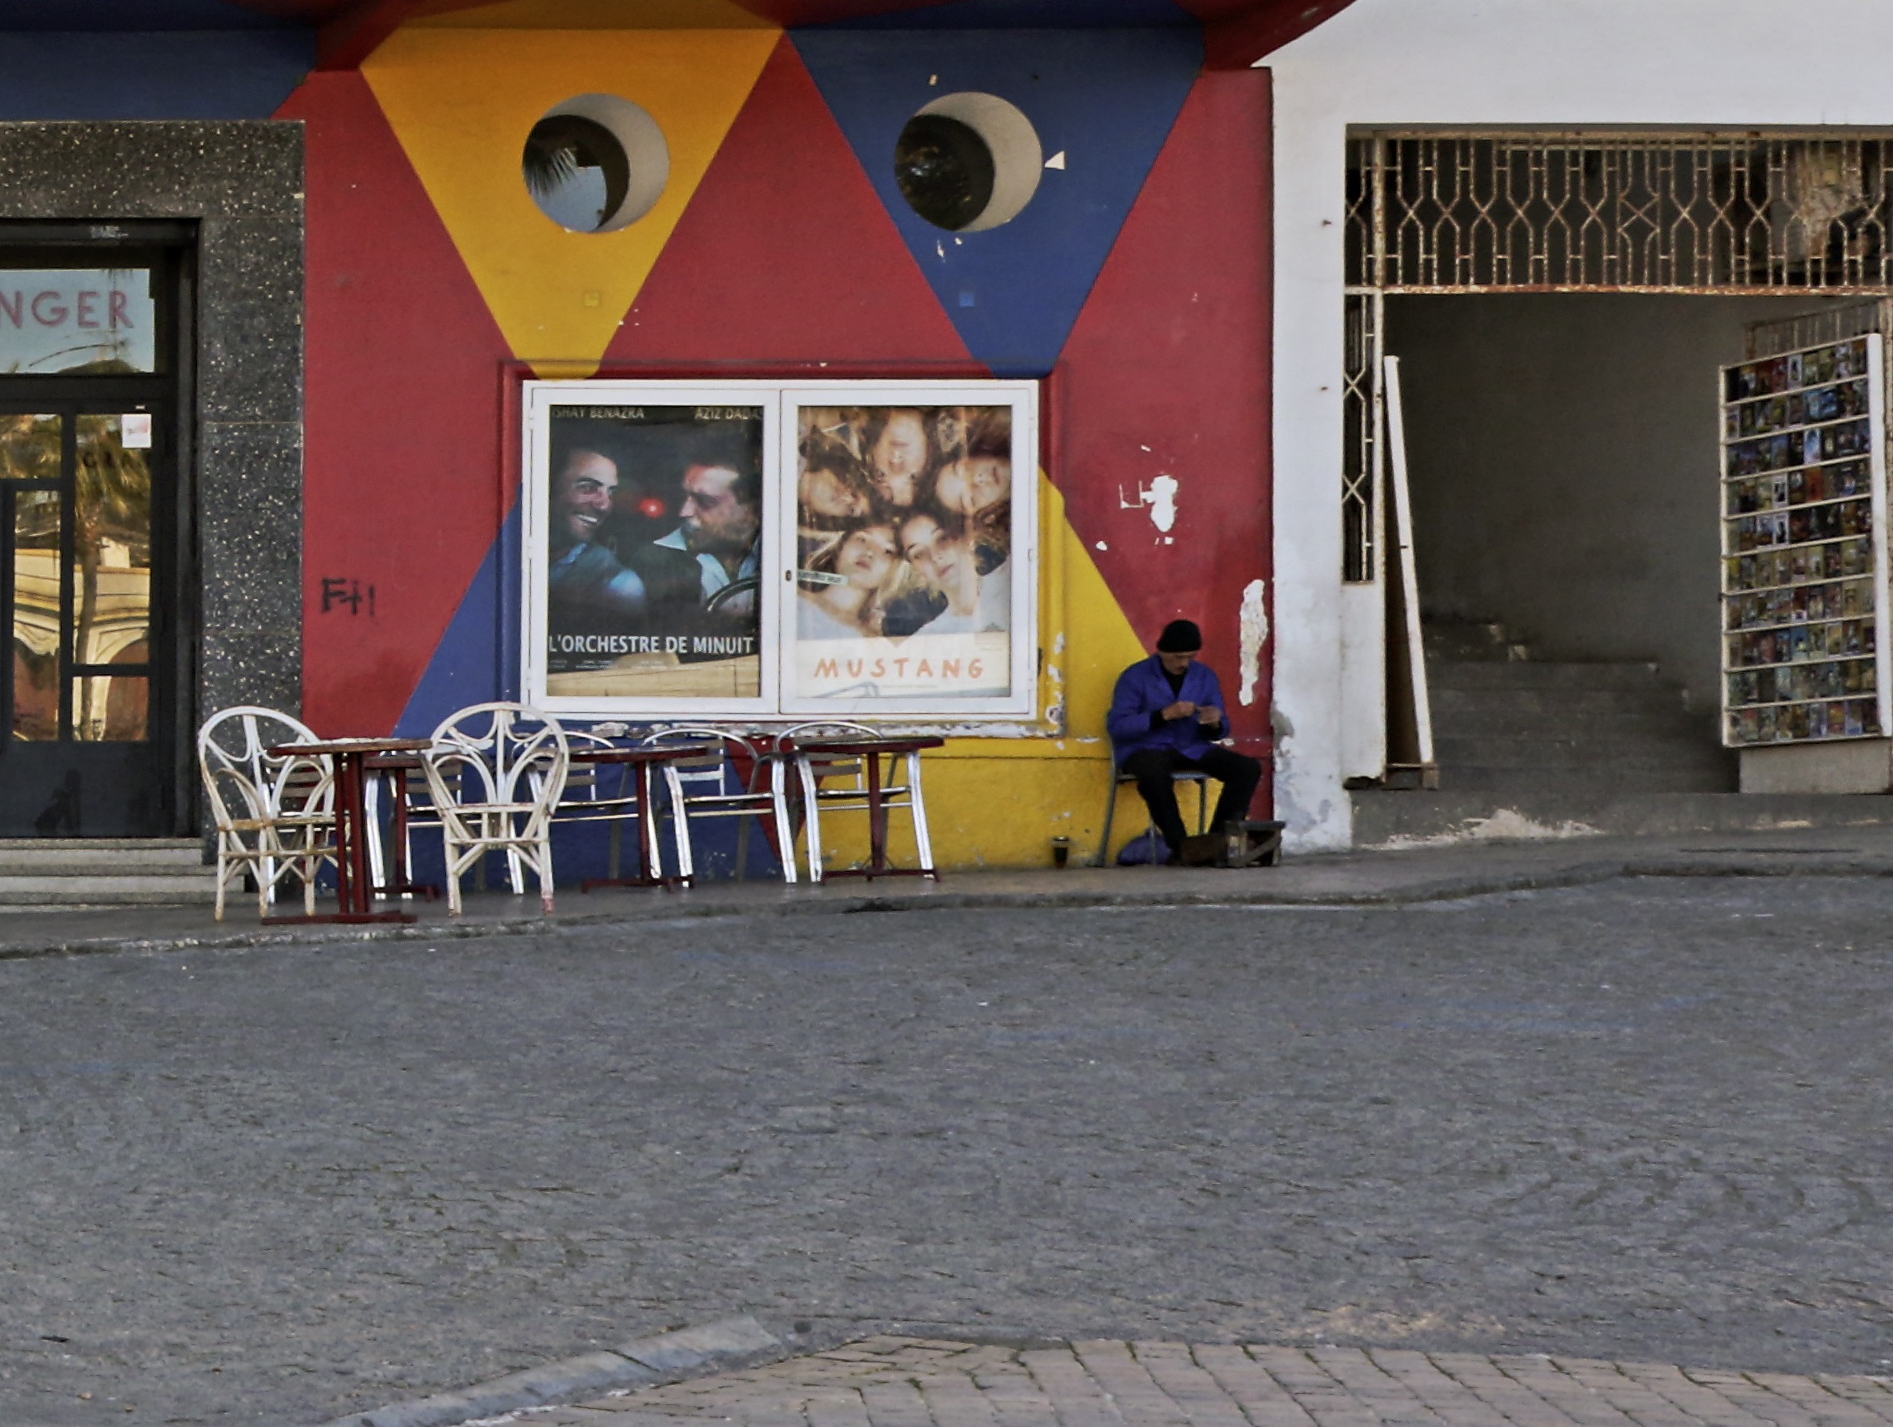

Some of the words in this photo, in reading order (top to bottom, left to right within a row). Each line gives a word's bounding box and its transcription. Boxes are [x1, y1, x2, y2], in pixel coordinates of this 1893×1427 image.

[549, 634, 660, 653] L'ORCHESTRE
[665, 635, 687, 653] DE
[693, 636, 754, 654] MINUIT
[814, 656, 984, 680] MUSTANG
